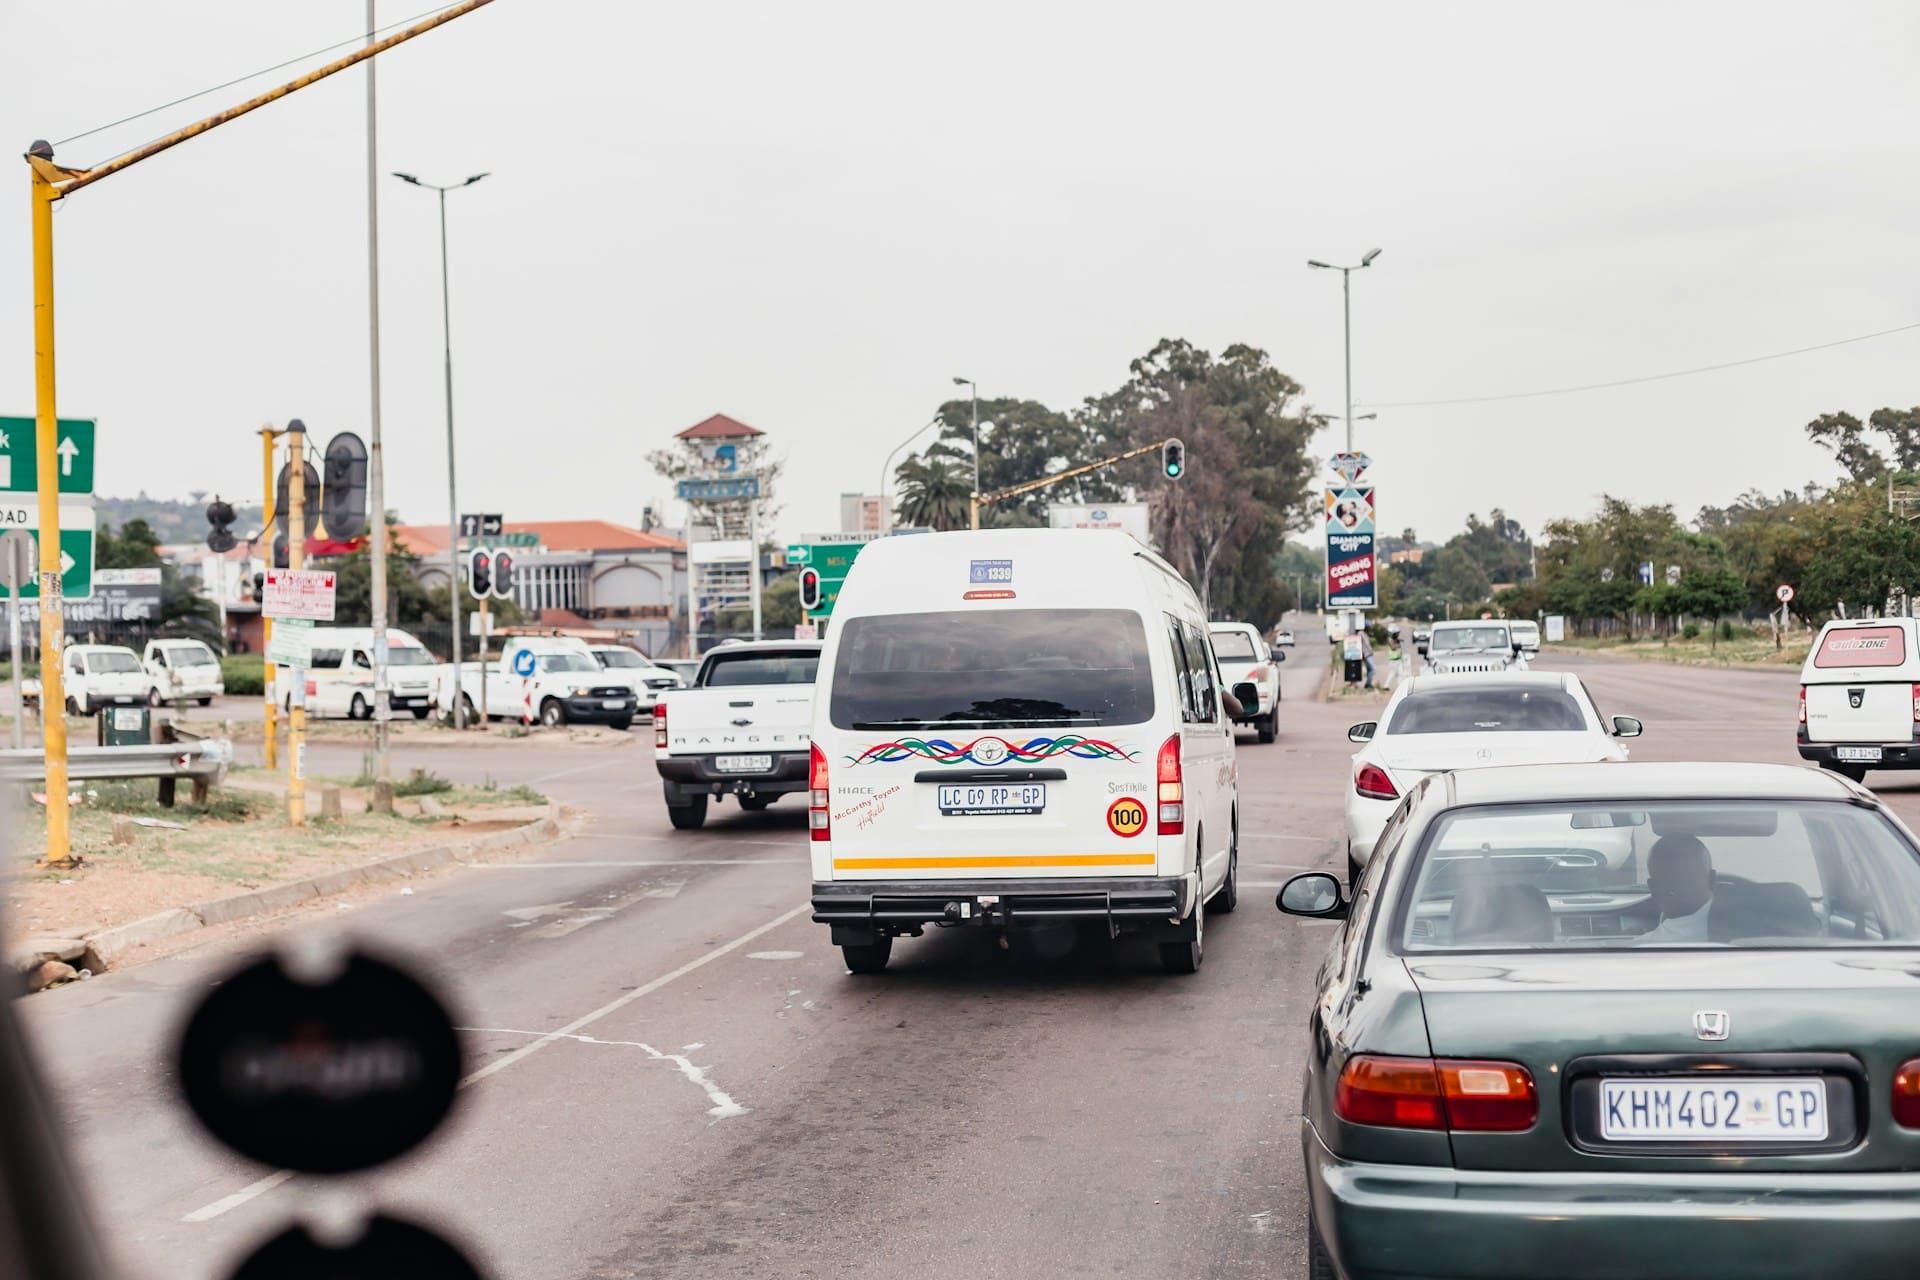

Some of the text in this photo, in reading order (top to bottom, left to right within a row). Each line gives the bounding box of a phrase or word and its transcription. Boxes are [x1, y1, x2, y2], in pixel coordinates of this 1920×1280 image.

[1330, 535, 1371, 545] DIAMOND
[1340, 544, 1359, 552] CITY
[1330, 557, 1371, 578] COMING
[1339, 570, 1369, 588] SOON
[675, 734, 810, 744] RANGER
[838, 786, 874, 795] HIACE
[944, 788, 1040, 806] LC 09 RP GP
[834, 785, 901, 820] McCarthy Toyota
[1113, 809, 1142, 825] 100
[1608, 1090, 1817, 1128] KHM402 GP
